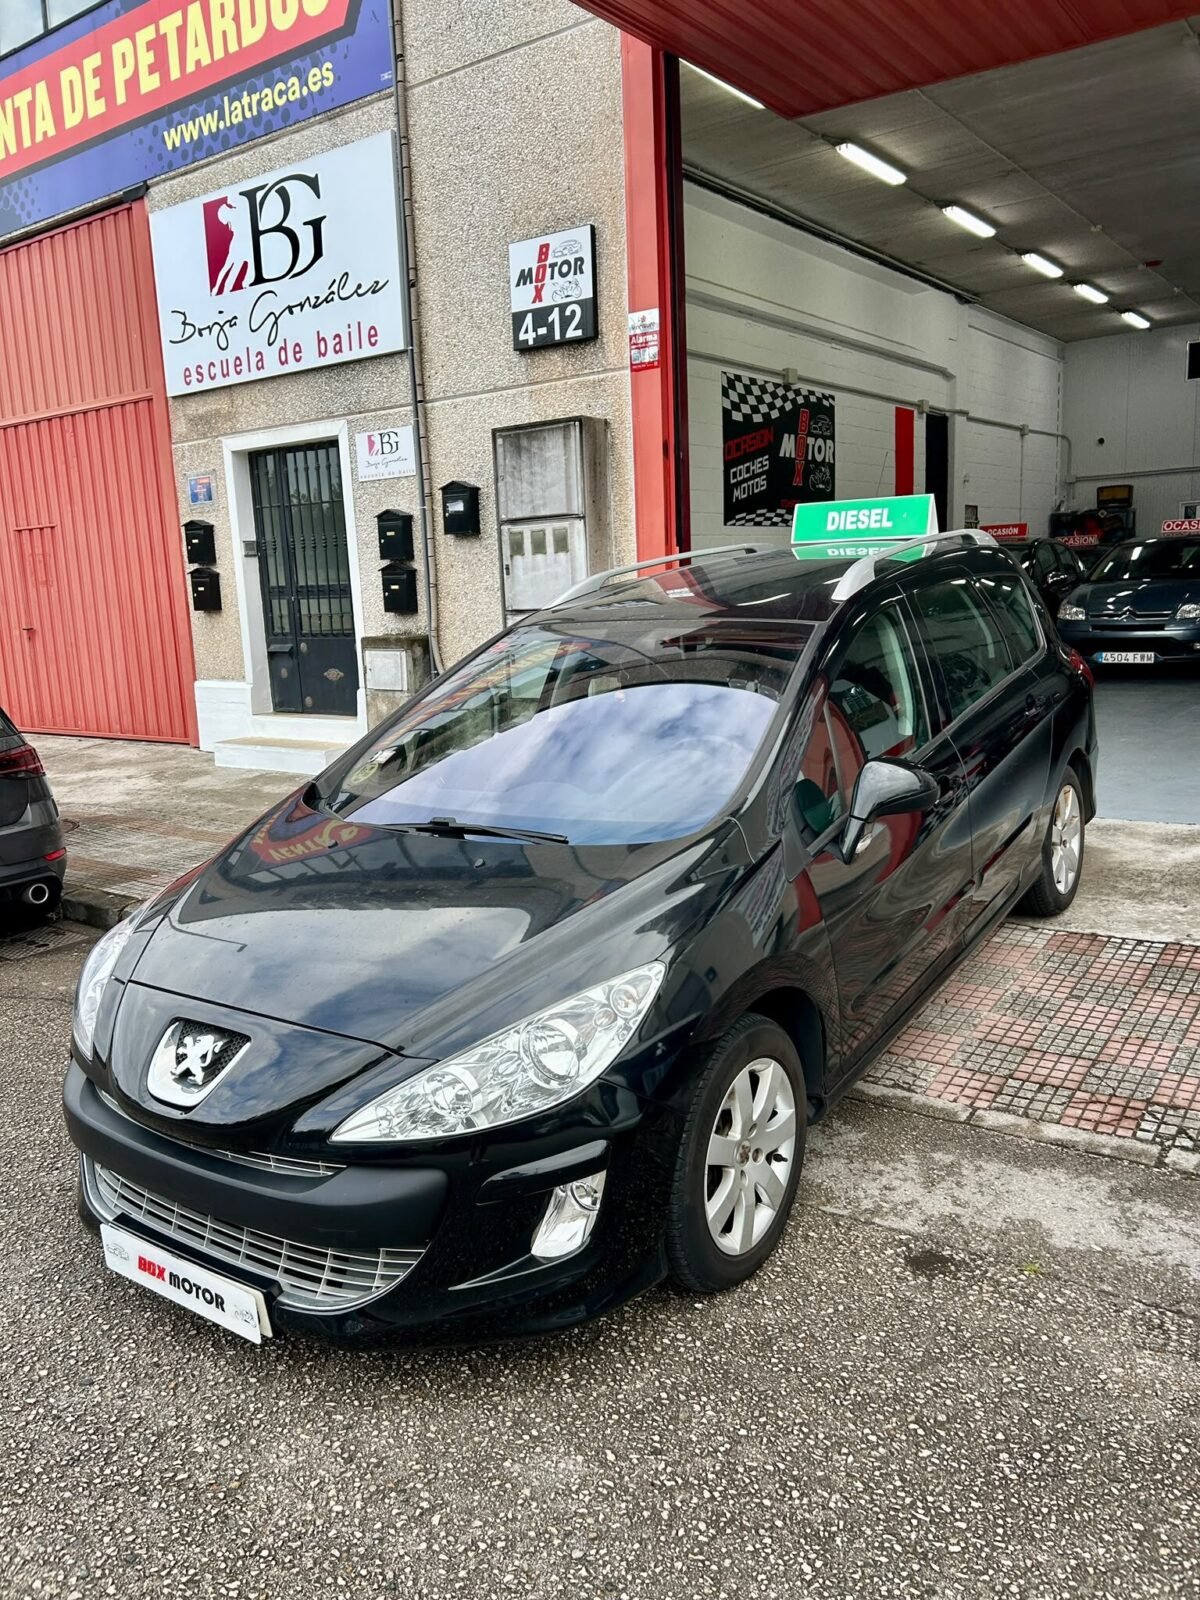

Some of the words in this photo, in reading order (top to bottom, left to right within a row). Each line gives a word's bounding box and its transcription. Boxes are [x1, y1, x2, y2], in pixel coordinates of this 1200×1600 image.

[60, 51, 106, 130] DE
[163, 61, 334, 150] www.latraca.es
[239, 173, 327, 287] BG
[531, 242, 550, 304] BOX
[169, 310, 238, 350] Borja
[248, 271, 389, 347] González
[518, 303, 583, 346] 4-12
[183, 346, 265, 386] escuela
[278, 339, 302, 367] de
[316, 320, 379, 359] baile
[631, 333, 658, 345] Alarma
[779, 432, 834, 463] MOTOR
[792, 408, 810, 486] BOX
[730, 454, 770, 484] COCHES
[732, 474, 767, 503] MOTOS
[826, 508, 893, 531] DIESEL
[1103, 653, 1130, 662] 4504
[137, 1255, 166, 1282] BOX
